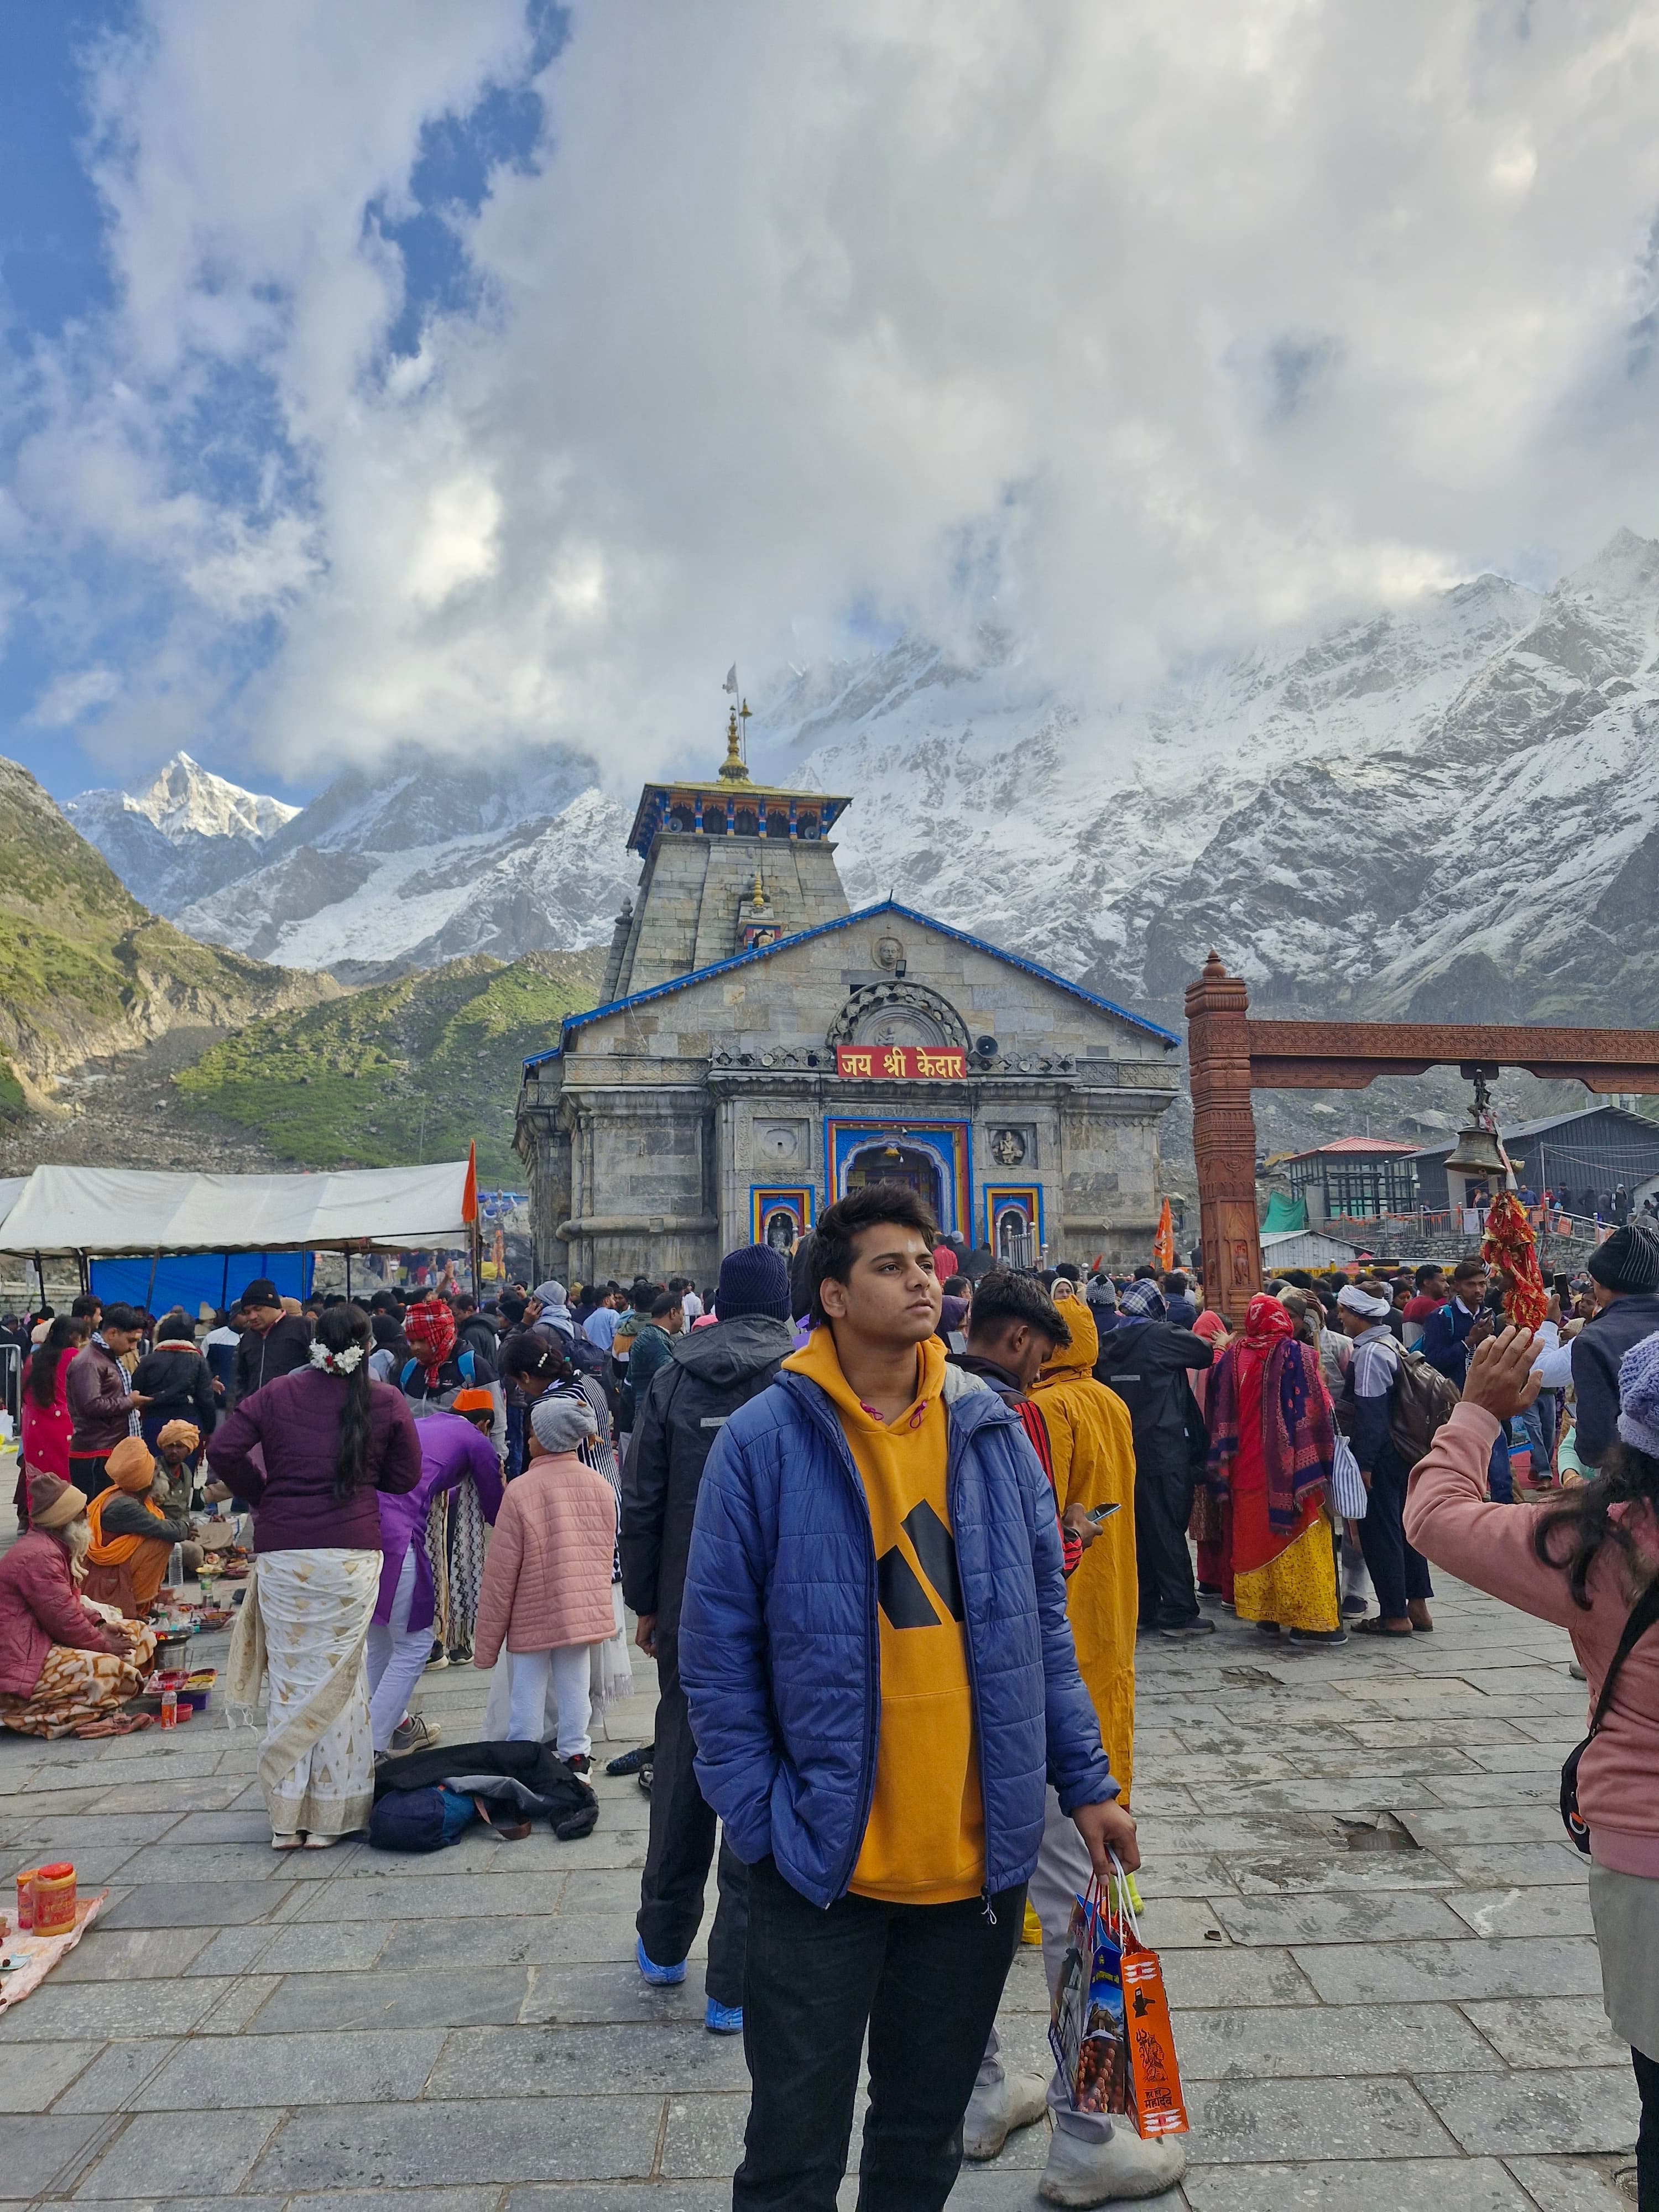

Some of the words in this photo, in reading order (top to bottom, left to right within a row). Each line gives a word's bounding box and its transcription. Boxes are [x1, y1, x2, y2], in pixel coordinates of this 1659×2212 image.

[841, 1055, 872, 1077] जय
[883, 1046, 906, 1077] श्री
[916, 1046, 963, 1078] केदार
